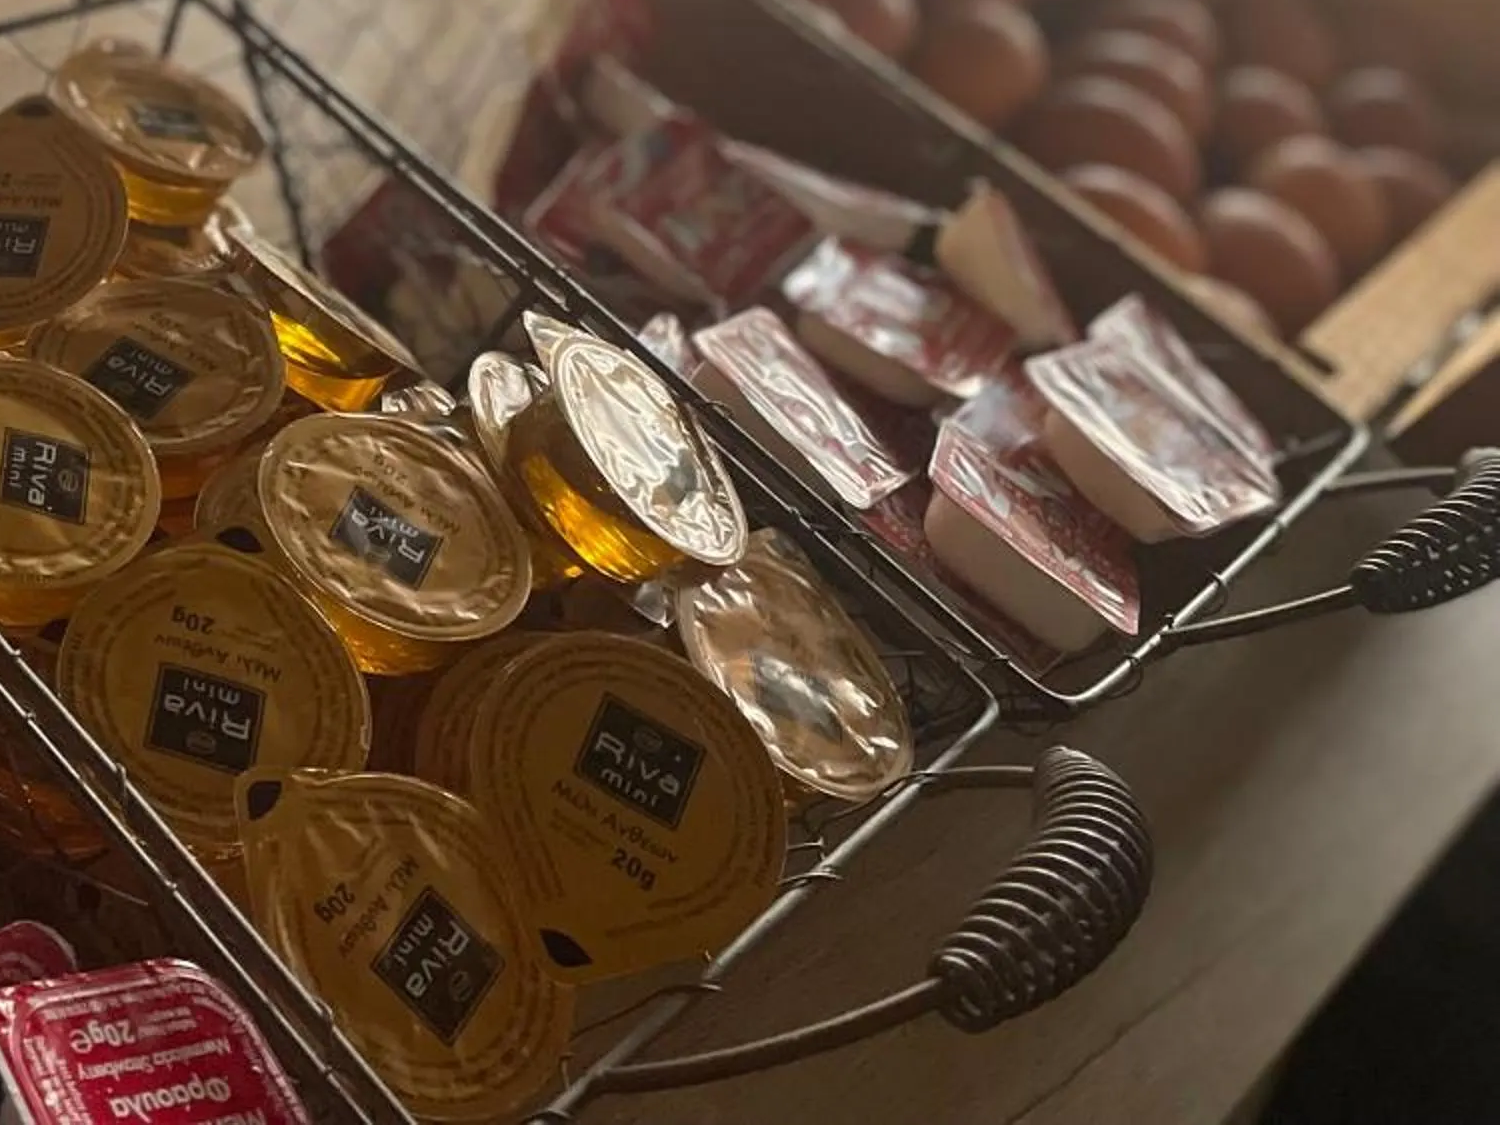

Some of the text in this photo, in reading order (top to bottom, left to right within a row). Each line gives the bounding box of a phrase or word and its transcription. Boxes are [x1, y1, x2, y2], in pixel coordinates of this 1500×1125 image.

[106, 355, 174, 396] Riva
[8, 445, 26, 488] mini
[27, 441, 57, 506] Riva
[351, 508, 425, 564] Riva
[171, 605, 216, 635] 20g
[183, 677, 241, 705] mini
[163, 693, 251, 740] Riva
[593, 731, 680, 797] Riva
[600, 767, 659, 808] mini
[611, 847, 657, 892] 20g
[313, 882, 356, 924] 20g
[393, 913, 435, 967] mini
[404, 919, 470, 998] Riva
[109, 1071, 232, 1124] Φράουλα
